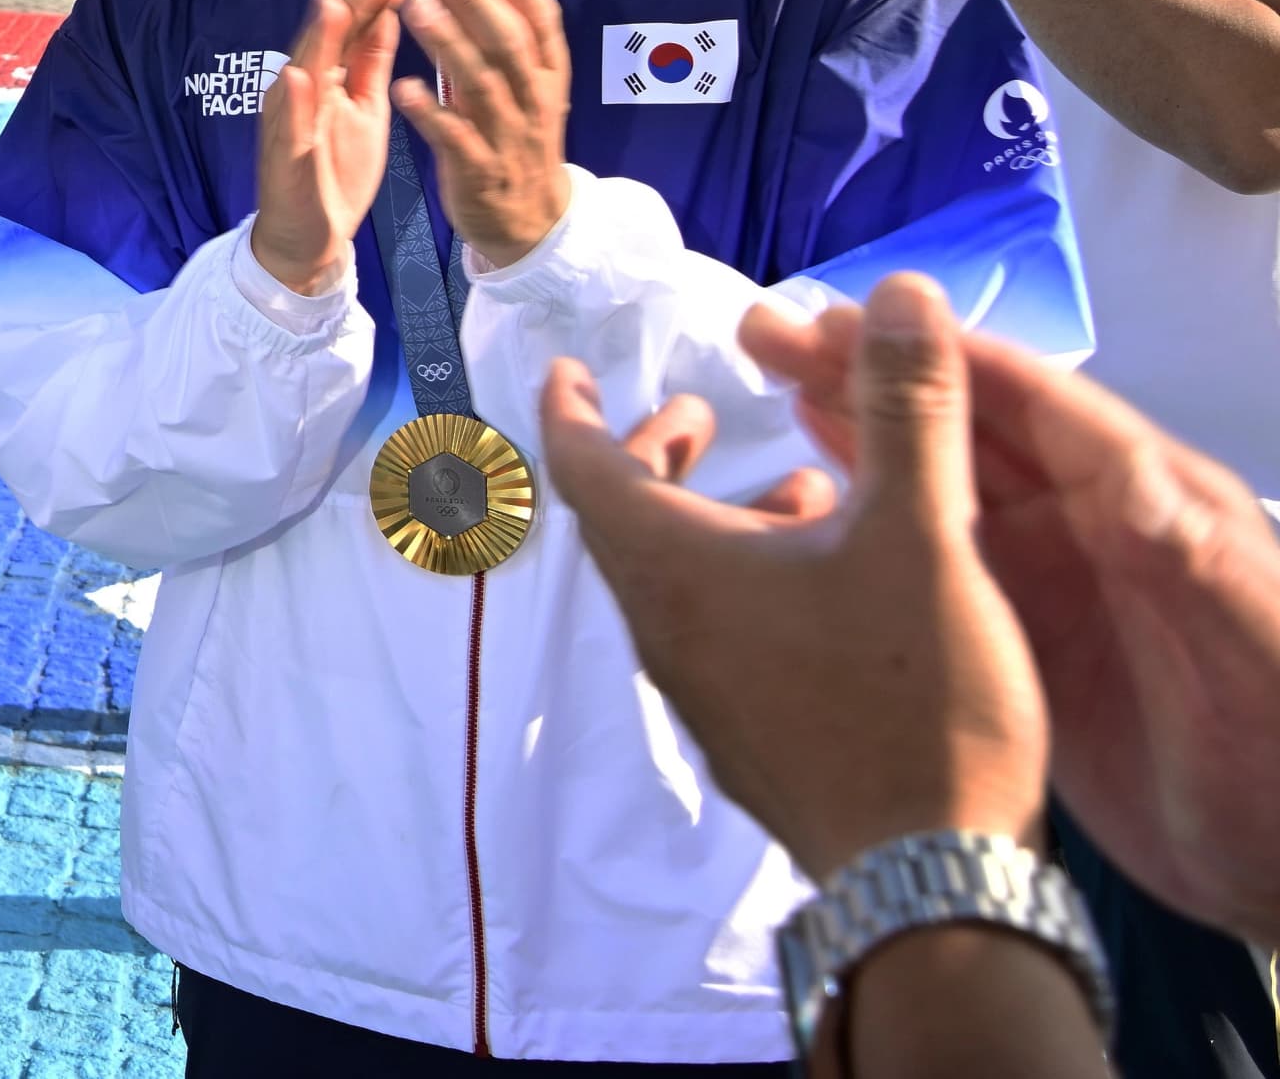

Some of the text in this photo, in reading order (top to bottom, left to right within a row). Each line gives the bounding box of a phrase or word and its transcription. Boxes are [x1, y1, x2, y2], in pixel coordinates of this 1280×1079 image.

[214, 51, 263, 73] THE
[184, 71, 260, 96] NORTH
[202, 92, 258, 116] FACE
